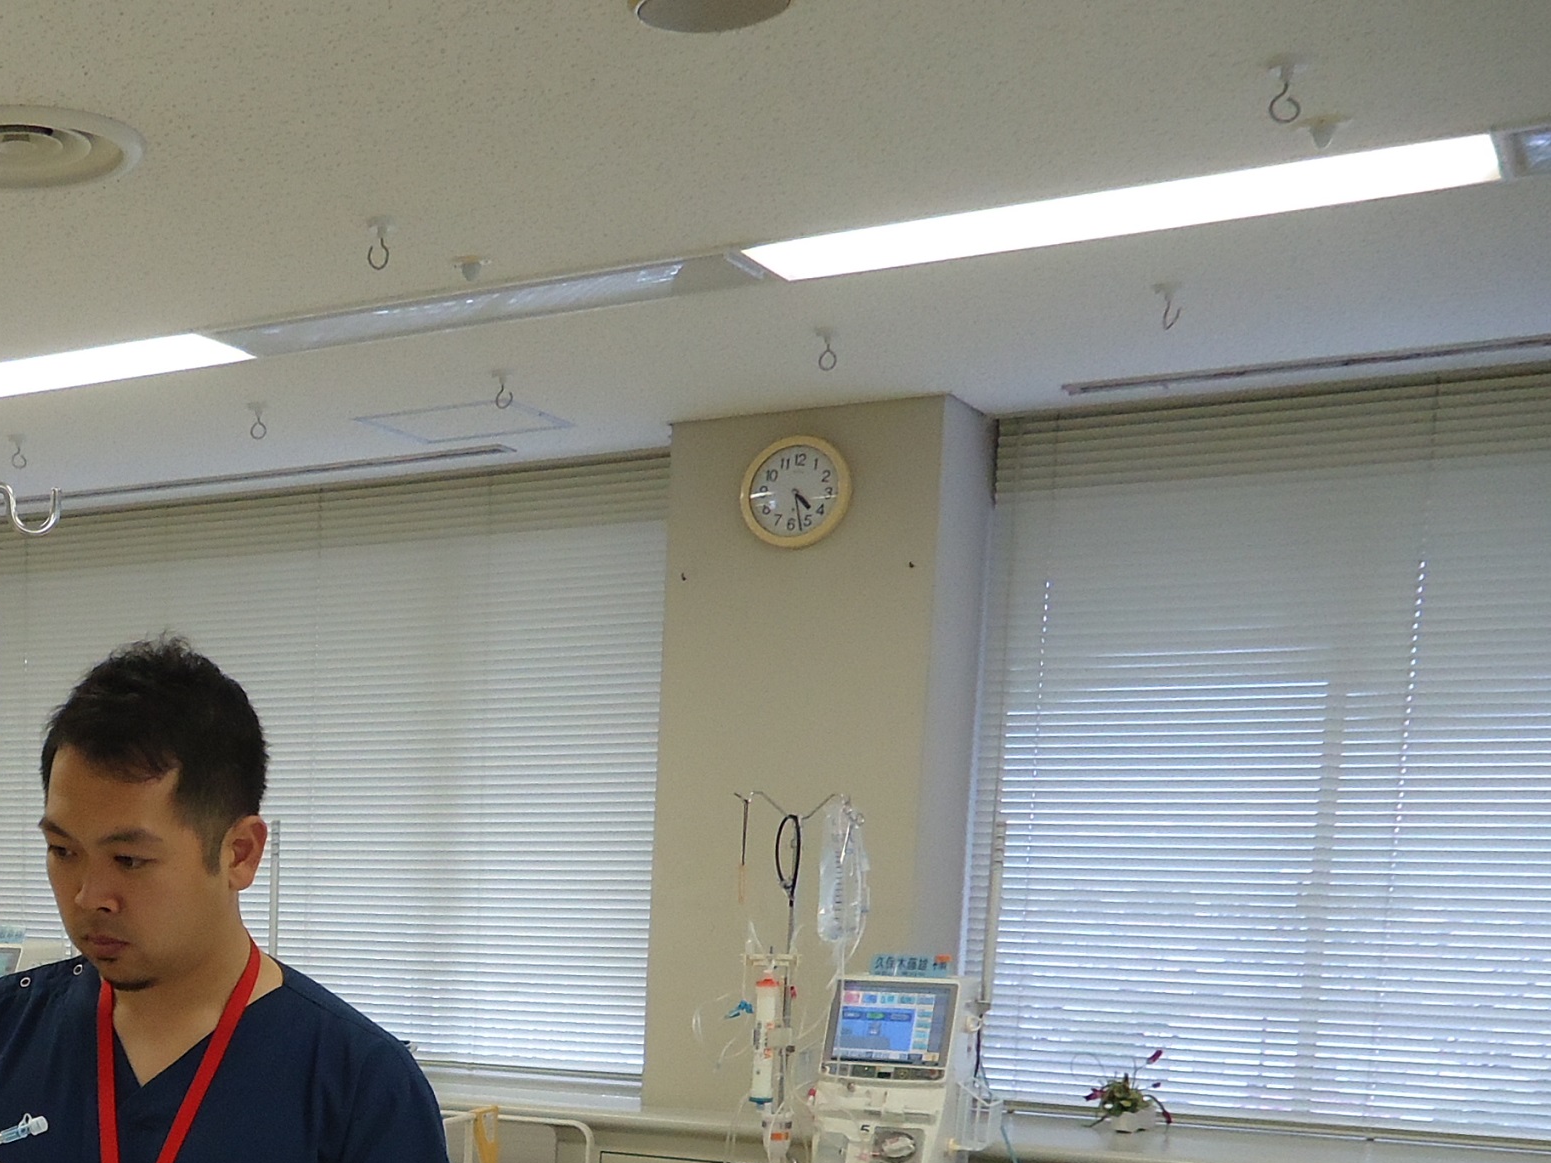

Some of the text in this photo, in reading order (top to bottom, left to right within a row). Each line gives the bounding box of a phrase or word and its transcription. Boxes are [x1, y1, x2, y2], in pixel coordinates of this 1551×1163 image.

[780, 458, 791, 470] 11
[794, 453, 807, 466] 12
[765, 469, 778, 482] 10
[821, 470, 831, 483] 2
[824, 486, 833, 500] 3
[816, 503, 825, 515] 4
[774, 513, 783, 527] 7
[787, 518, 796, 531] 6
[803, 514, 812, 527] 5
